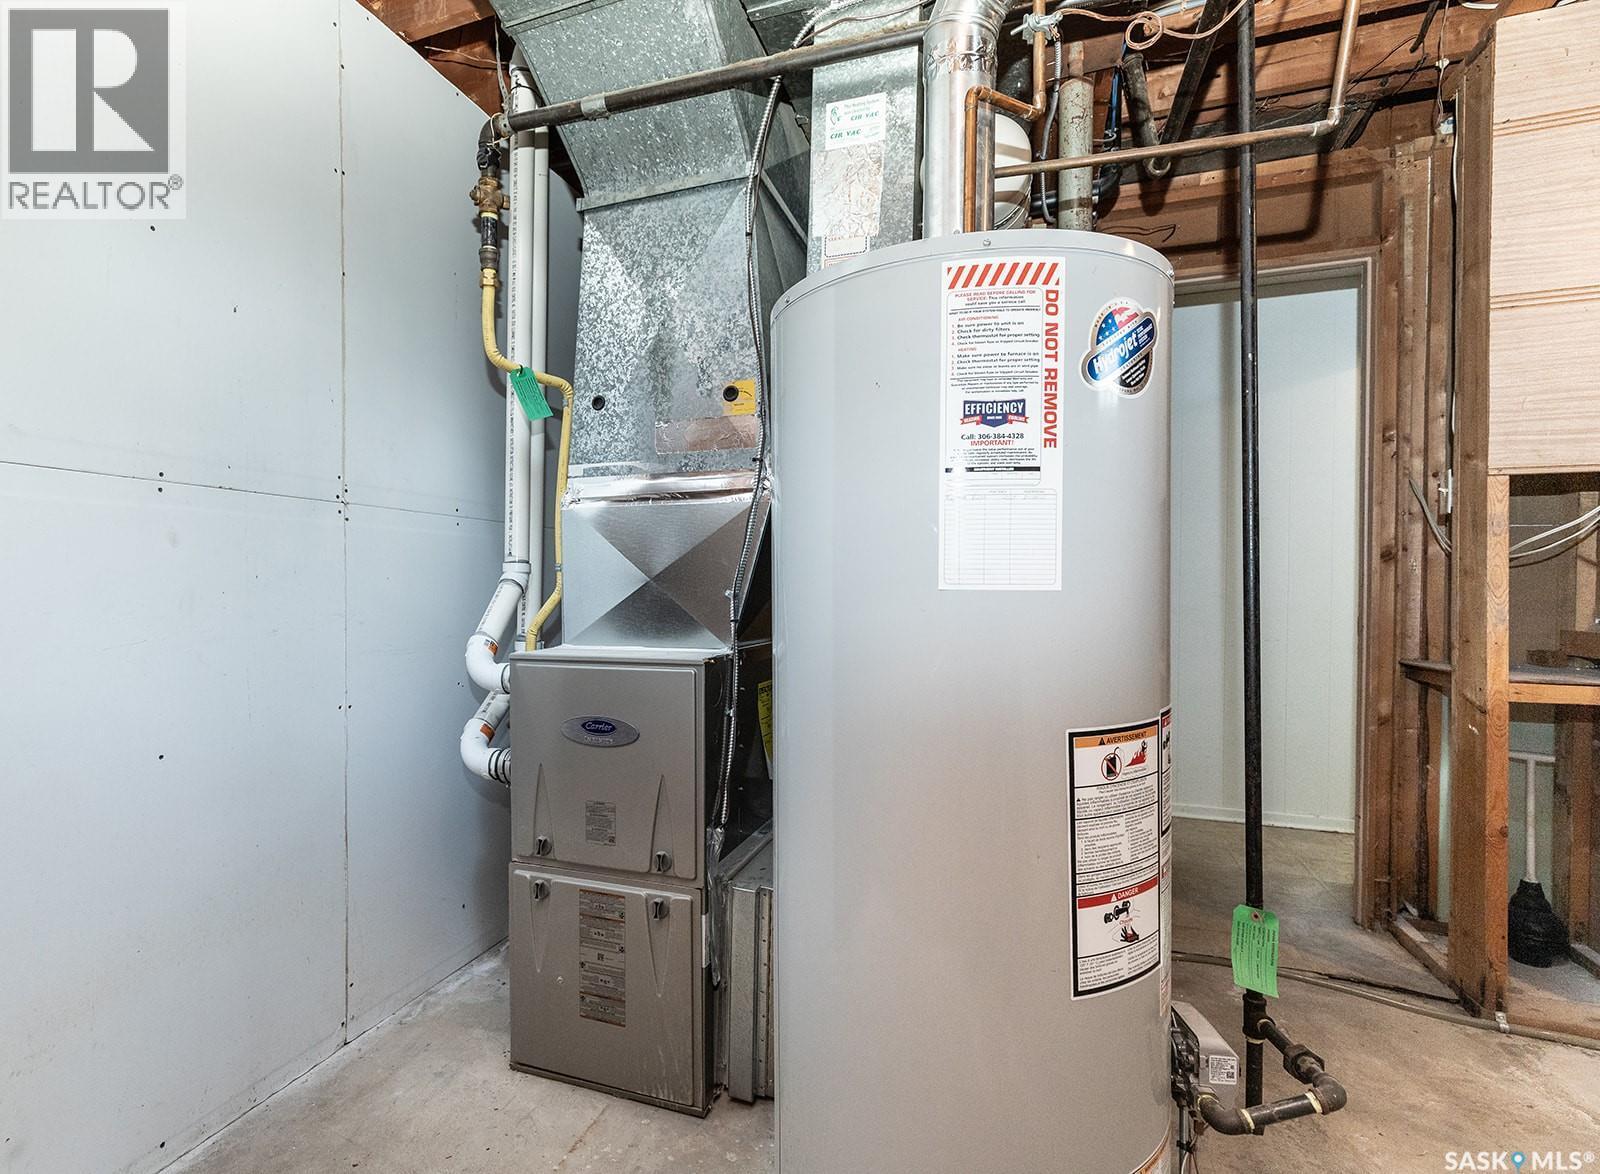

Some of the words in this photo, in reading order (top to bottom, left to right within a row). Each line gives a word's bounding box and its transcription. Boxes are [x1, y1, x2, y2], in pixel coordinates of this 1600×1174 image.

[1045, 290, 1059, 316] DO
[1044, 322, 1059, 362] NOT
[965, 402, 1024, 415] EFFICIENCY
[1043, 368, 1058, 448] REMOVE
[978, 432, 1025, 440] 306-384-4328
[585, 721, 612, 731] Carrier
[1106, 731, 1147, 744] AVERTISSEMENT
[1117, 887, 1139, 899] DANGER
